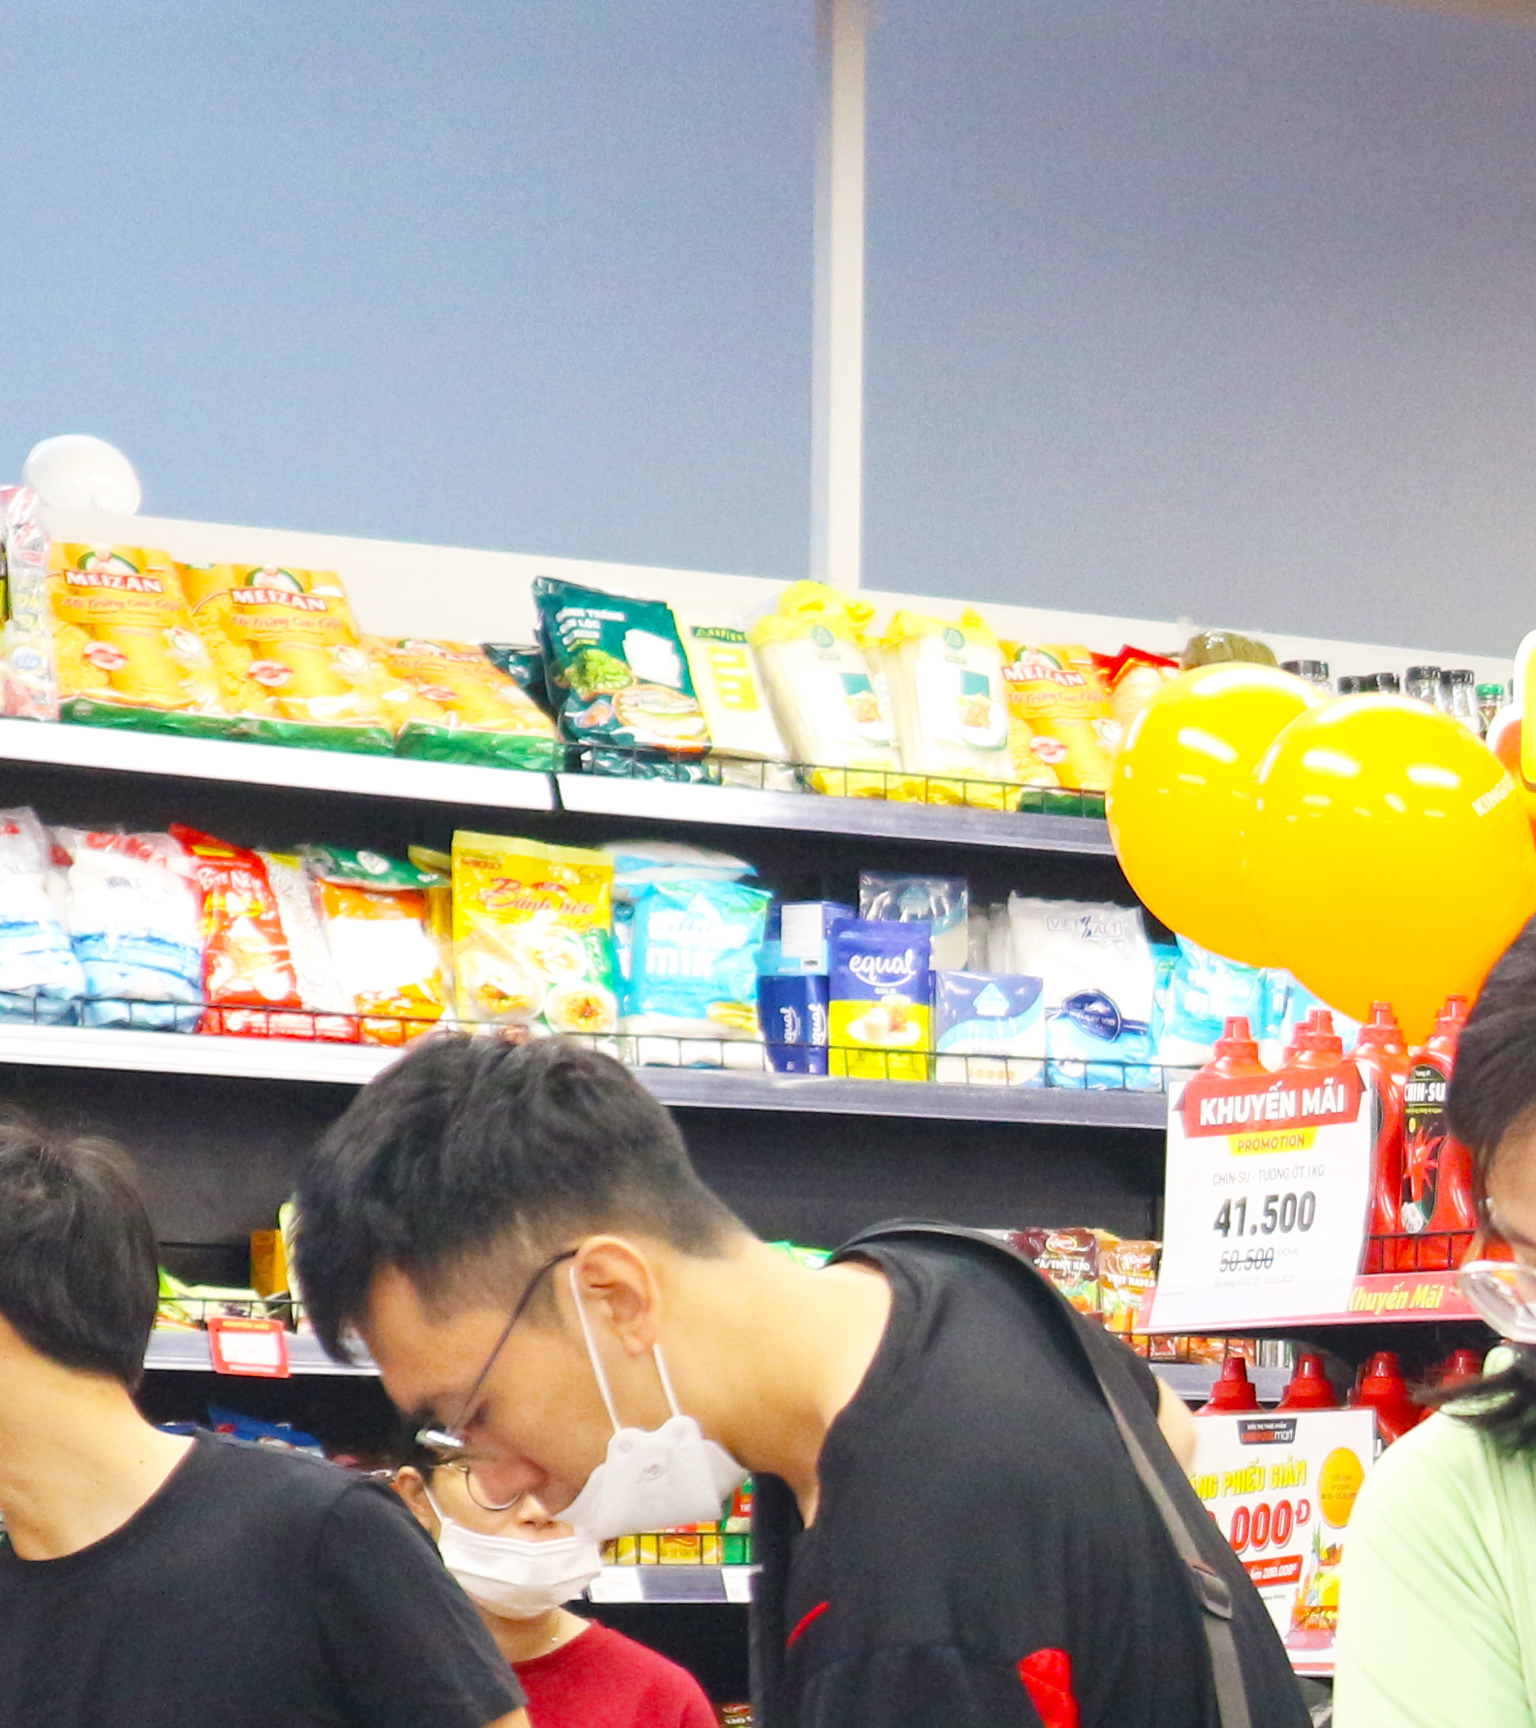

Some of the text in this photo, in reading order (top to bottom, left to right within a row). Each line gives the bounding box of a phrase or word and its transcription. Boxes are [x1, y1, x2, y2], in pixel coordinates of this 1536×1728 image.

[66, 569, 163, 594] MEIZAN
[232, 588, 328, 612] MEIZAN
[1003, 664, 1086, 687] MEIZAN
[849, 948, 917, 984] equal
[1200, 1077, 1346, 1127] KHUYẾN MÃI
[1237, 1133, 1305, 1152] PROMOTION
[1212, 1170, 1251, 1186] CHIN-SU
[1213, 1191, 1317, 1239] 41.500
[1219, 1246, 1275, 1273] 50.500
[1350, 1281, 1444, 1315] huyến Mãi
[1222, 1457, 1266, 1498] PHIẾU
[1269, 1454, 1307, 1490] GIẢM
